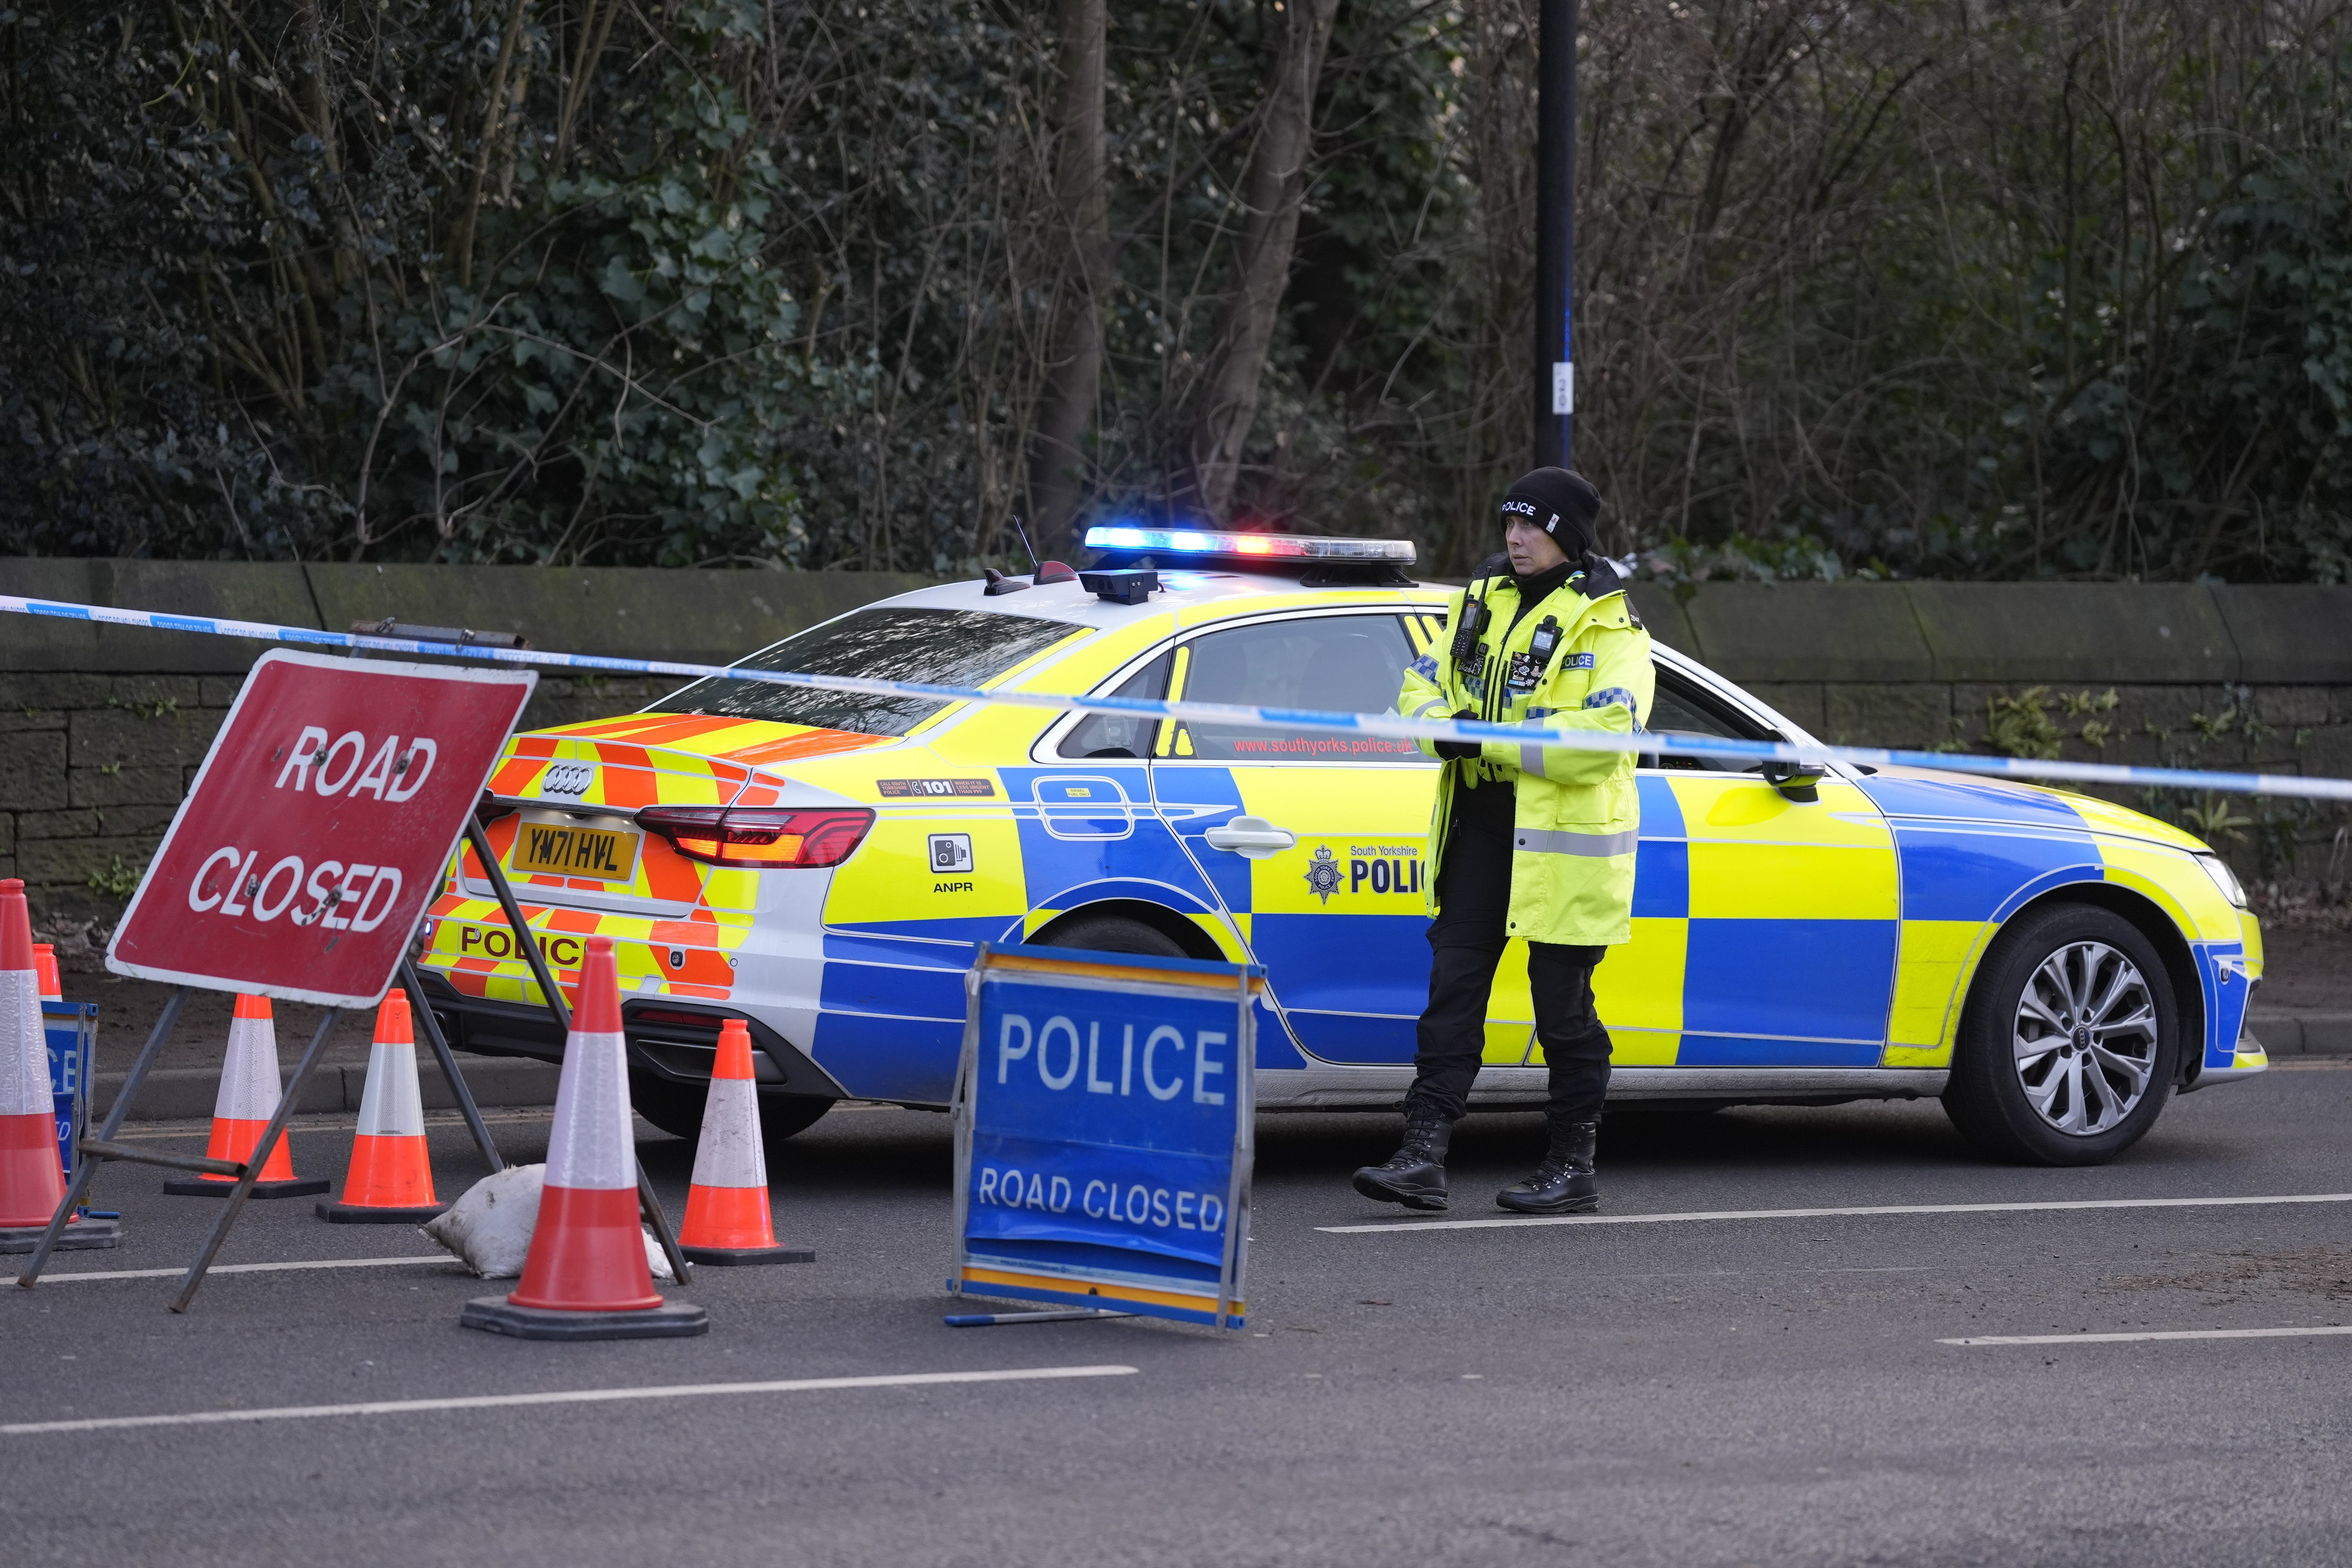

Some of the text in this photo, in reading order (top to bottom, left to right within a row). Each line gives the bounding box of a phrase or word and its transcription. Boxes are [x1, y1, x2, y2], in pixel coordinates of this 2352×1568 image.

[1502, 501, 1536, 516] POLICE
[274, 725, 437, 803] ROAD
[1233, 737, 1412, 756] www.southyorks.police.uk
[922, 781, 953, 793] 101
[528, 828, 617, 871] YM71 HVL
[1351, 846, 1417, 856] South Yorkshire
[188, 846, 403, 933] CLOSED
[933, 882, 973, 893] ANPR
[1320, 866, 1334, 882] YORKSHIRE
[1351, 858, 1425, 893] POLI
[462, 926, 589, 965] POLIC
[997, 1013, 1227, 1105] POLICE
[979, 1167, 1222, 1232] ROAD CLOSED
